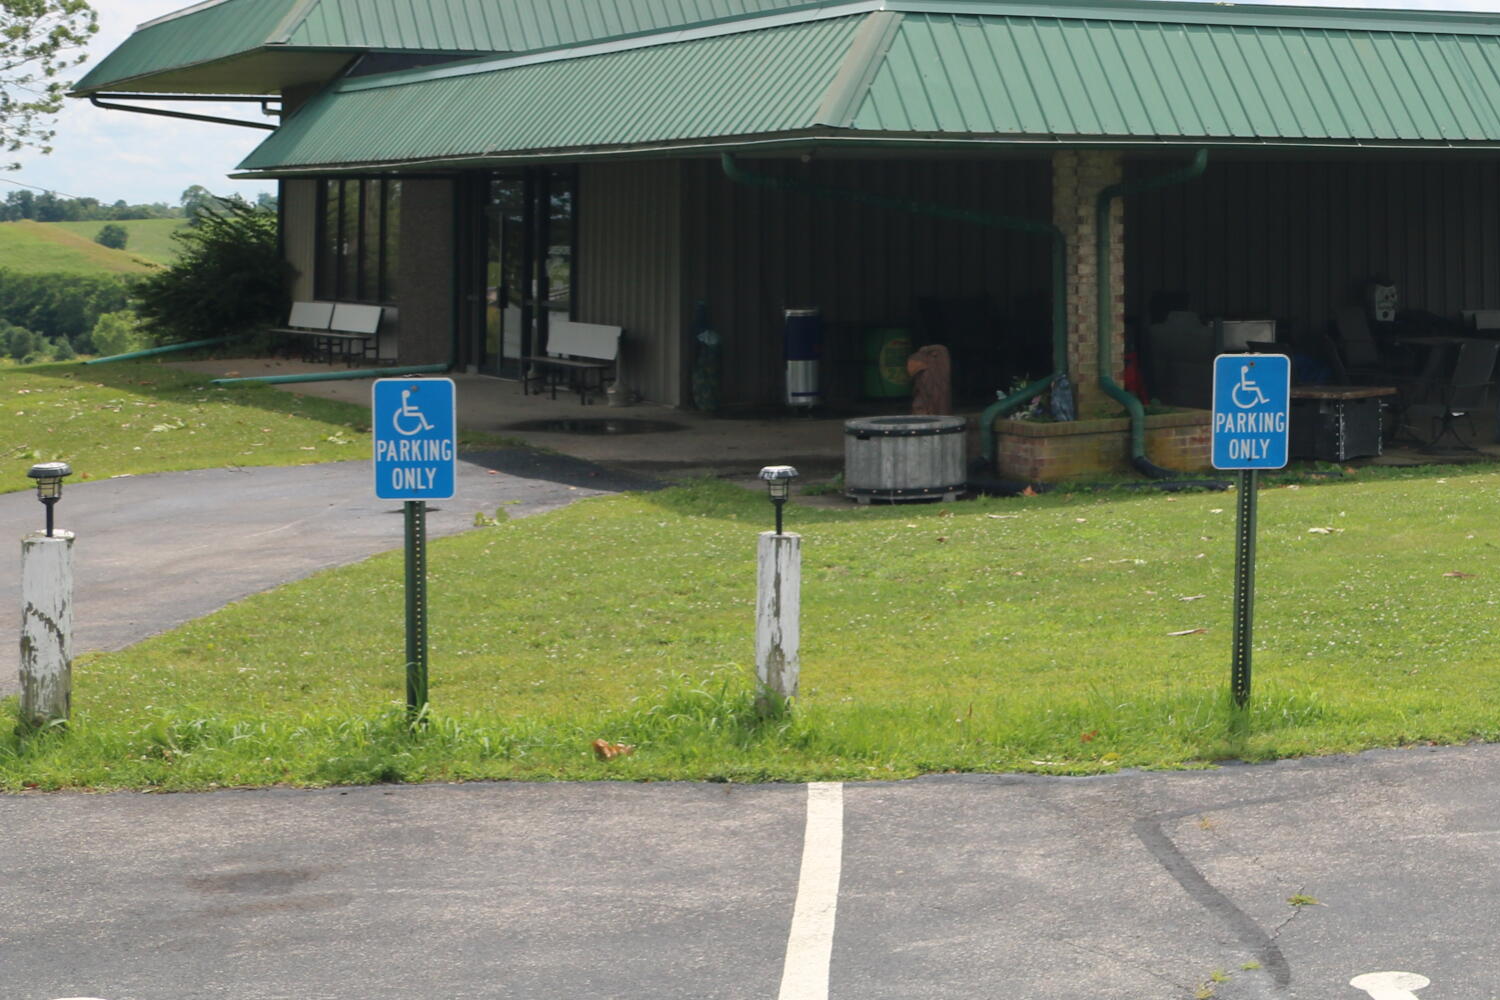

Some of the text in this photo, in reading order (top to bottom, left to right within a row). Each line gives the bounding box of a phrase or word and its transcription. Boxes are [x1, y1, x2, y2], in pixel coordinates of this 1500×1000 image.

[1215, 412, 1285, 433] PARKING
[376, 439, 453, 461] PARKING
[1229, 438, 1271, 459] ONLY
[392, 467, 437, 490] ONLY
